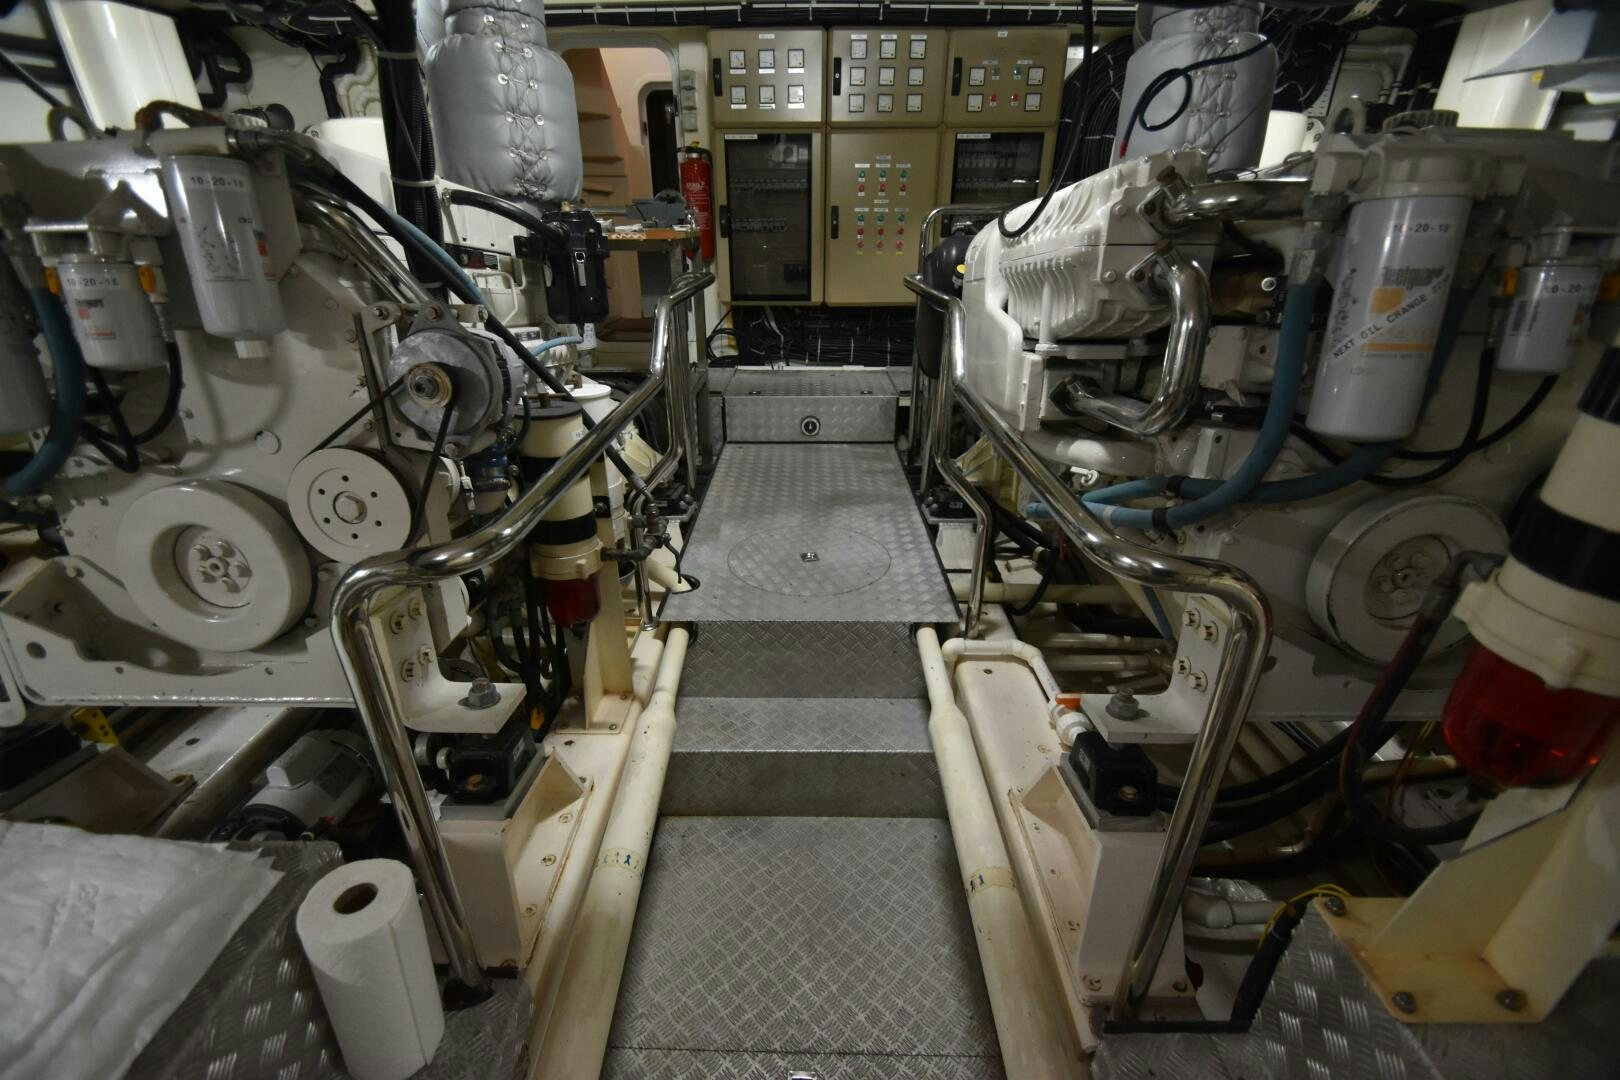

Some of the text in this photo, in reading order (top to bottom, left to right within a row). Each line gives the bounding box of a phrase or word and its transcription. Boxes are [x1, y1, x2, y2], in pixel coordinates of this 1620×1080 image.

[1332, 338, 1356, 360] NEXT
[1360, 324, 1385, 340] OIL
[1386, 293, 1428, 324] CHANGE
